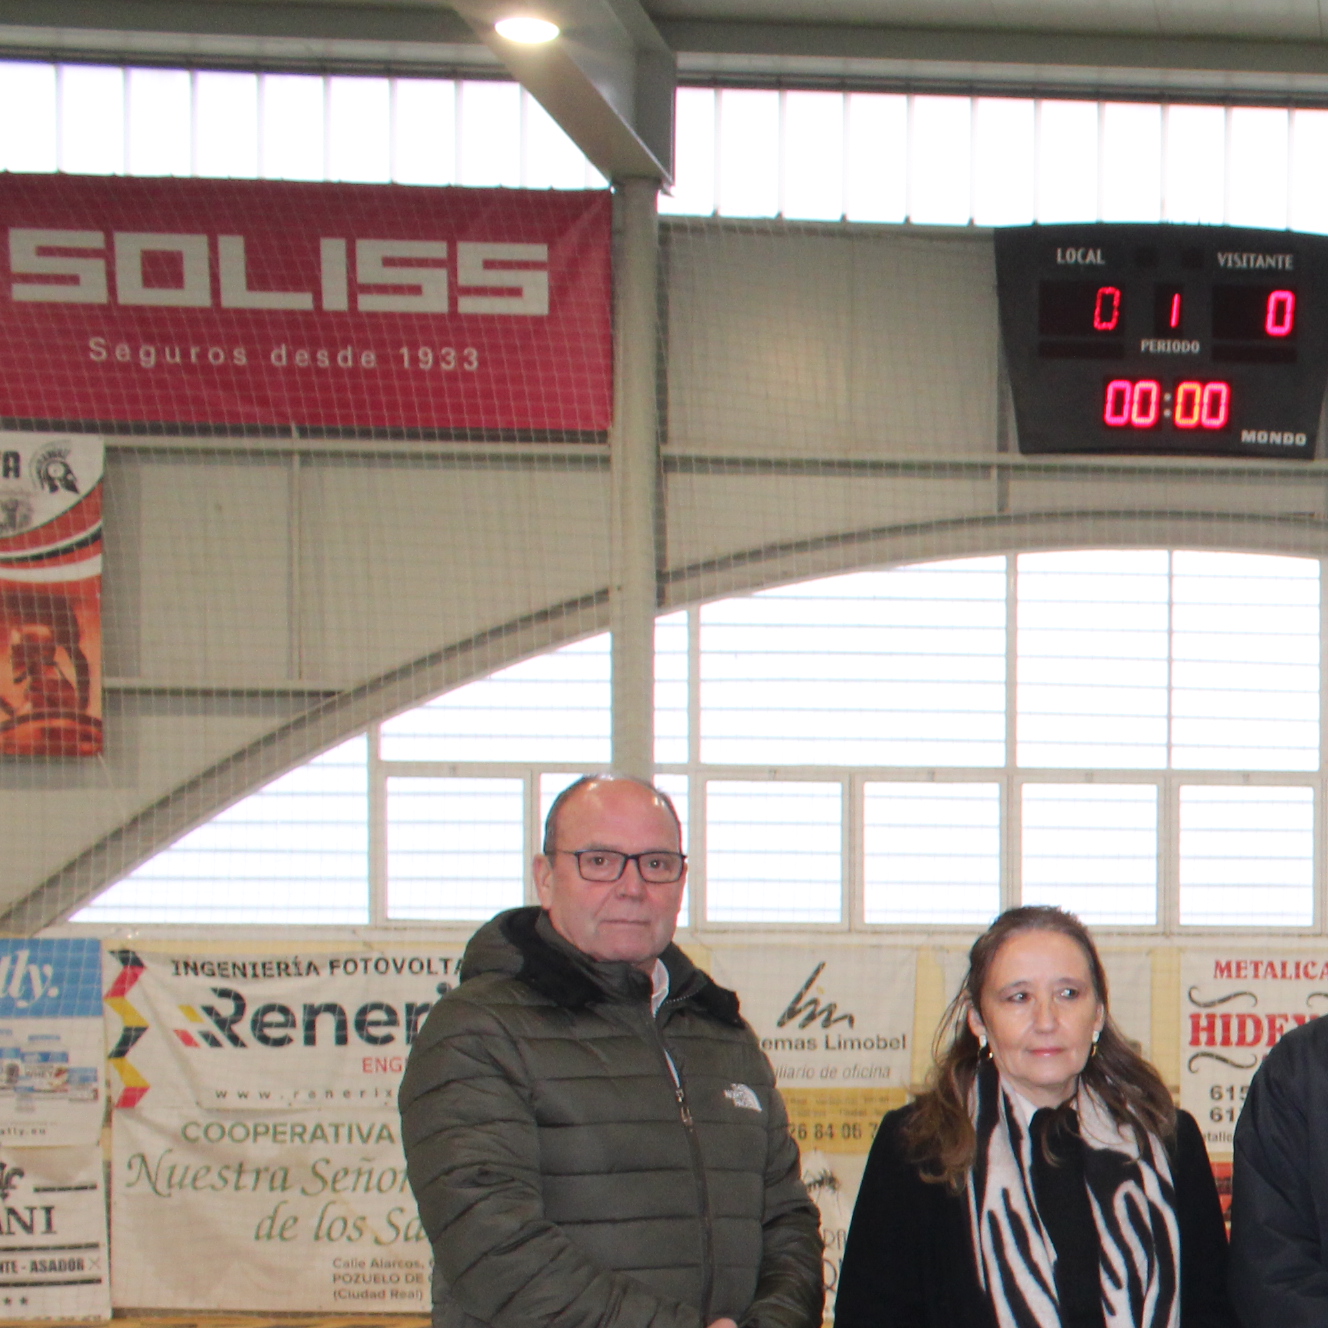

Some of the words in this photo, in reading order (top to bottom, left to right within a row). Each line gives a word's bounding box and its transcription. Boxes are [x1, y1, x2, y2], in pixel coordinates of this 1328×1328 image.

[8, 228, 549, 316] SOLISS
[1056, 248, 1106, 266] LOCAL
[1217, 253, 1294, 271] VISITANTE
[1093, 286, 1122, 331] 0
[1169, 292, 1183, 329] 1
[1264, 289, 1296, 337] 0
[89, 337, 247, 368] Seguros
[272, 344, 377, 368] desde
[400, 347, 480, 371] 1933
[1140, 339, 1201, 355] PERIODO
[1103, 379, 1230, 430] 00:00
[1240, 429, 1307, 447] MONDO
[170, 955, 321, 979] INGENIERÍA
[198, 982, 452, 1049] Rener
[1188, 1013, 1325, 1048] HIDE
[760, 1036, 818, 1051] emas
[824, 1033, 907, 1051] Limobel
[819, 1063, 837, 1080] de
[841, 1063, 892, 1080] oficina
[181, 1121, 396, 1144] COOPERATIVA
[125, 1148, 293, 1198] Nuestra
[0, 1206, 57, 1236] NI
[254, 1200, 299, 1242] de
[313, 1200, 367, 1242] los
[29, 1257, 85, 1274] ASADOR
[332, 1272, 400, 1285] POZUELO
[405, 1273, 425, 1285] DE
